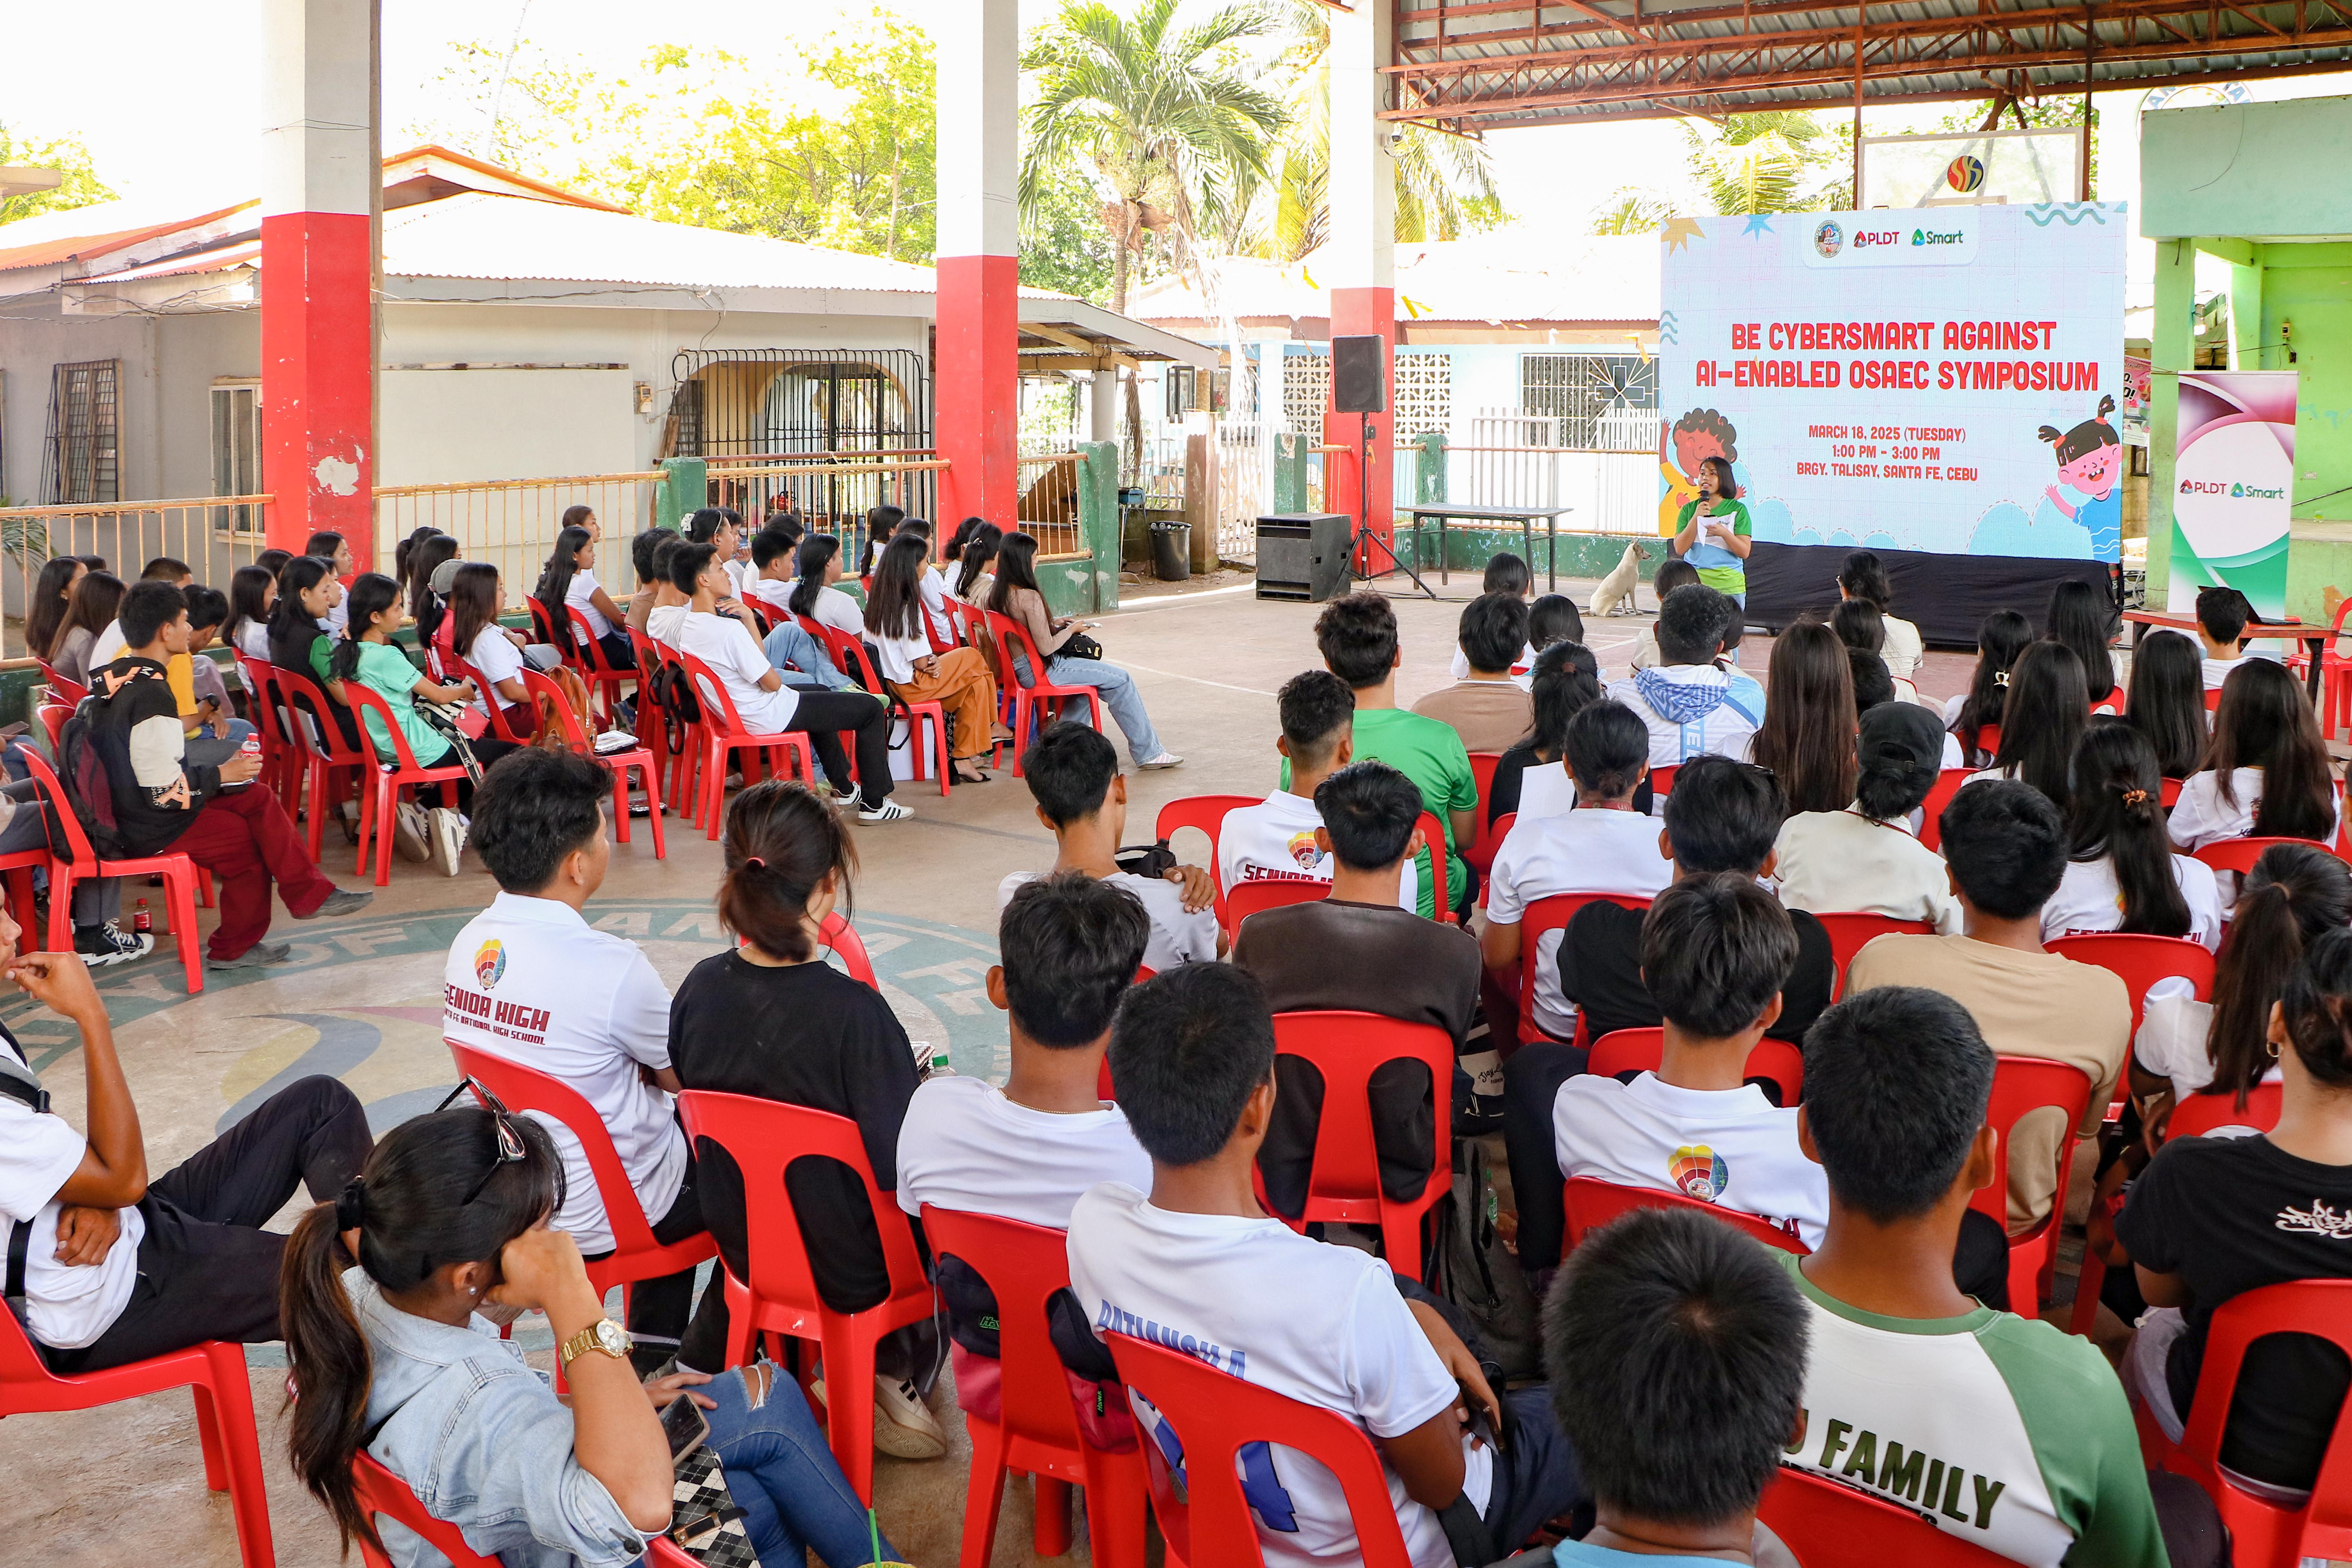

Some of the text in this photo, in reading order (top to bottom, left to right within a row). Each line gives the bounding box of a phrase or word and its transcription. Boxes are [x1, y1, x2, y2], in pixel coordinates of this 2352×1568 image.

[1868, 232, 1900, 245] PLDT
[1926, 230, 1964, 245] Smart
[1732, 321, 2056, 350] BE CYBERSMART AGAINST
[1696, 360, 2098, 391] AI-ENABLED OSAEC SYMPOSIUM
[1809, 425, 1966, 443] MARCH 18, 2025 (TUESDAY)
[1832, 445, 1855, 457] 1:00
[1859, 445, 1877, 458] PM
[1892, 446, 1918, 460] 3:00
[1922, 447, 1940, 460] PM
[1797, 462, 1978, 481] BRGY. TALISAY, SANTA FE, CEBU
[2194, 481, 2227, 495] PLDT
[2245, 485, 2285, 500] Smart
[444, 982, 550, 1032] SENIOR HIGH
[453, 1013, 459, 1022] FE
[461, 1016, 491, 1032] NATIONAL
[493, 1025, 509, 1037] HIGH
[511, 1031, 546, 1045] SCHOOL
[1819, 1418, 2005, 1530] FAMILY
